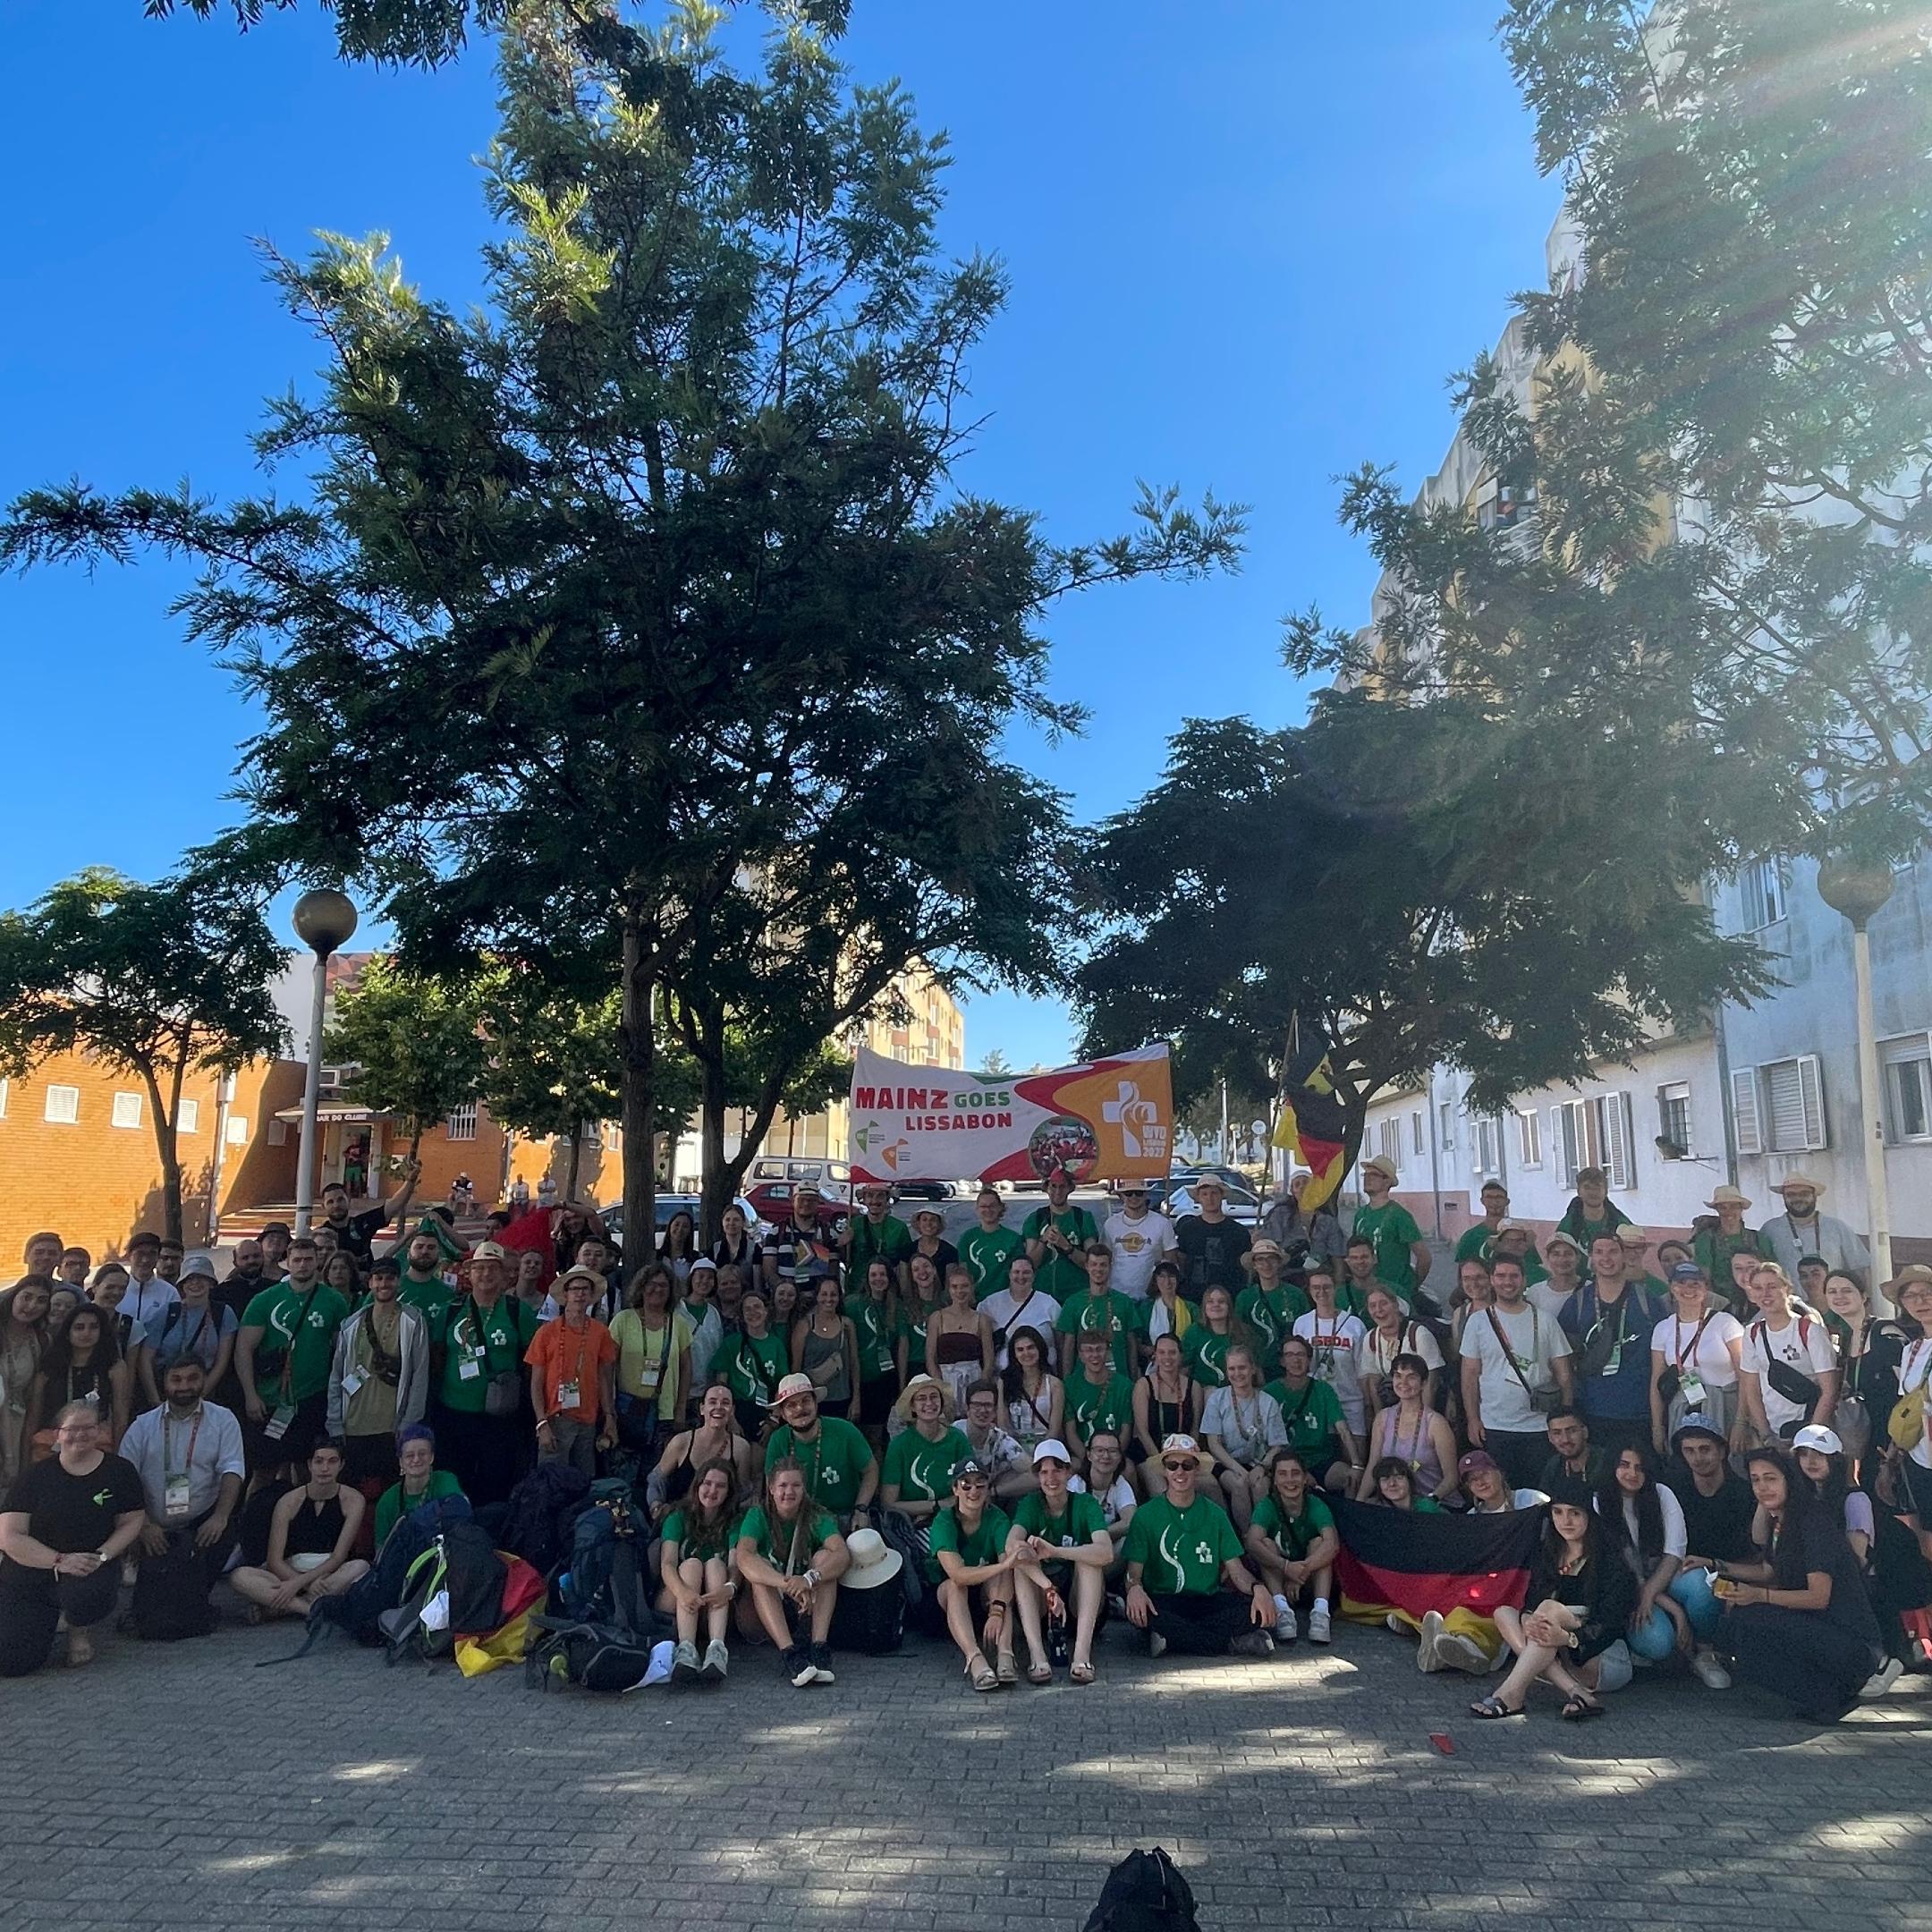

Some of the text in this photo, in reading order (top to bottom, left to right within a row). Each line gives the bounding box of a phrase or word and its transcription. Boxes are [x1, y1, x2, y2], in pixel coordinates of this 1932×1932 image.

[855, 1087, 1011, 1110] MAINZ GOES
[905, 1113, 1013, 1131] LISSABON
